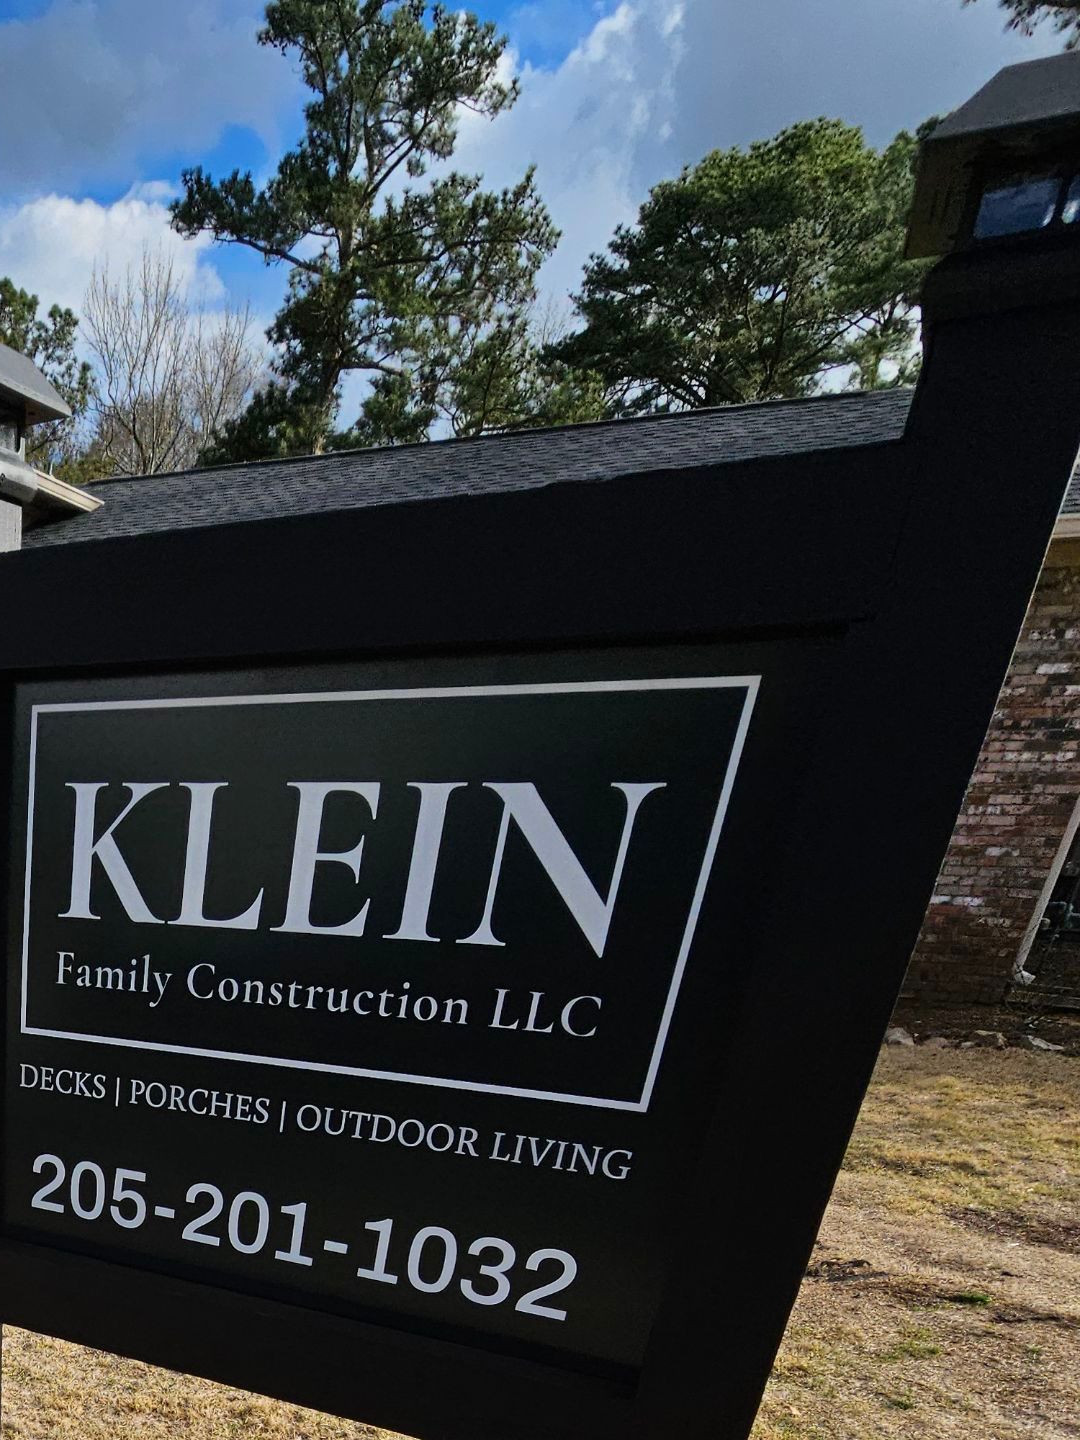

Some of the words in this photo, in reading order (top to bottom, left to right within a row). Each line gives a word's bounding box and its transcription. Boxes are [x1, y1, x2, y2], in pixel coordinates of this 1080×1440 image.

[57, 781, 668, 959] KLEIN
[56, 950, 174, 1008] Family
[186, 962, 469, 1026] Construction
[488, 987, 603, 1038] LLC
[19, 1062, 107, 1100] DECKS
[129, 1079, 271, 1125] PORCHES
[295, 1103, 480, 1158] OUTDOOR
[488, 1130, 634, 1181] LIVING
[30, 1152, 580, 1322] 205-201-1032
